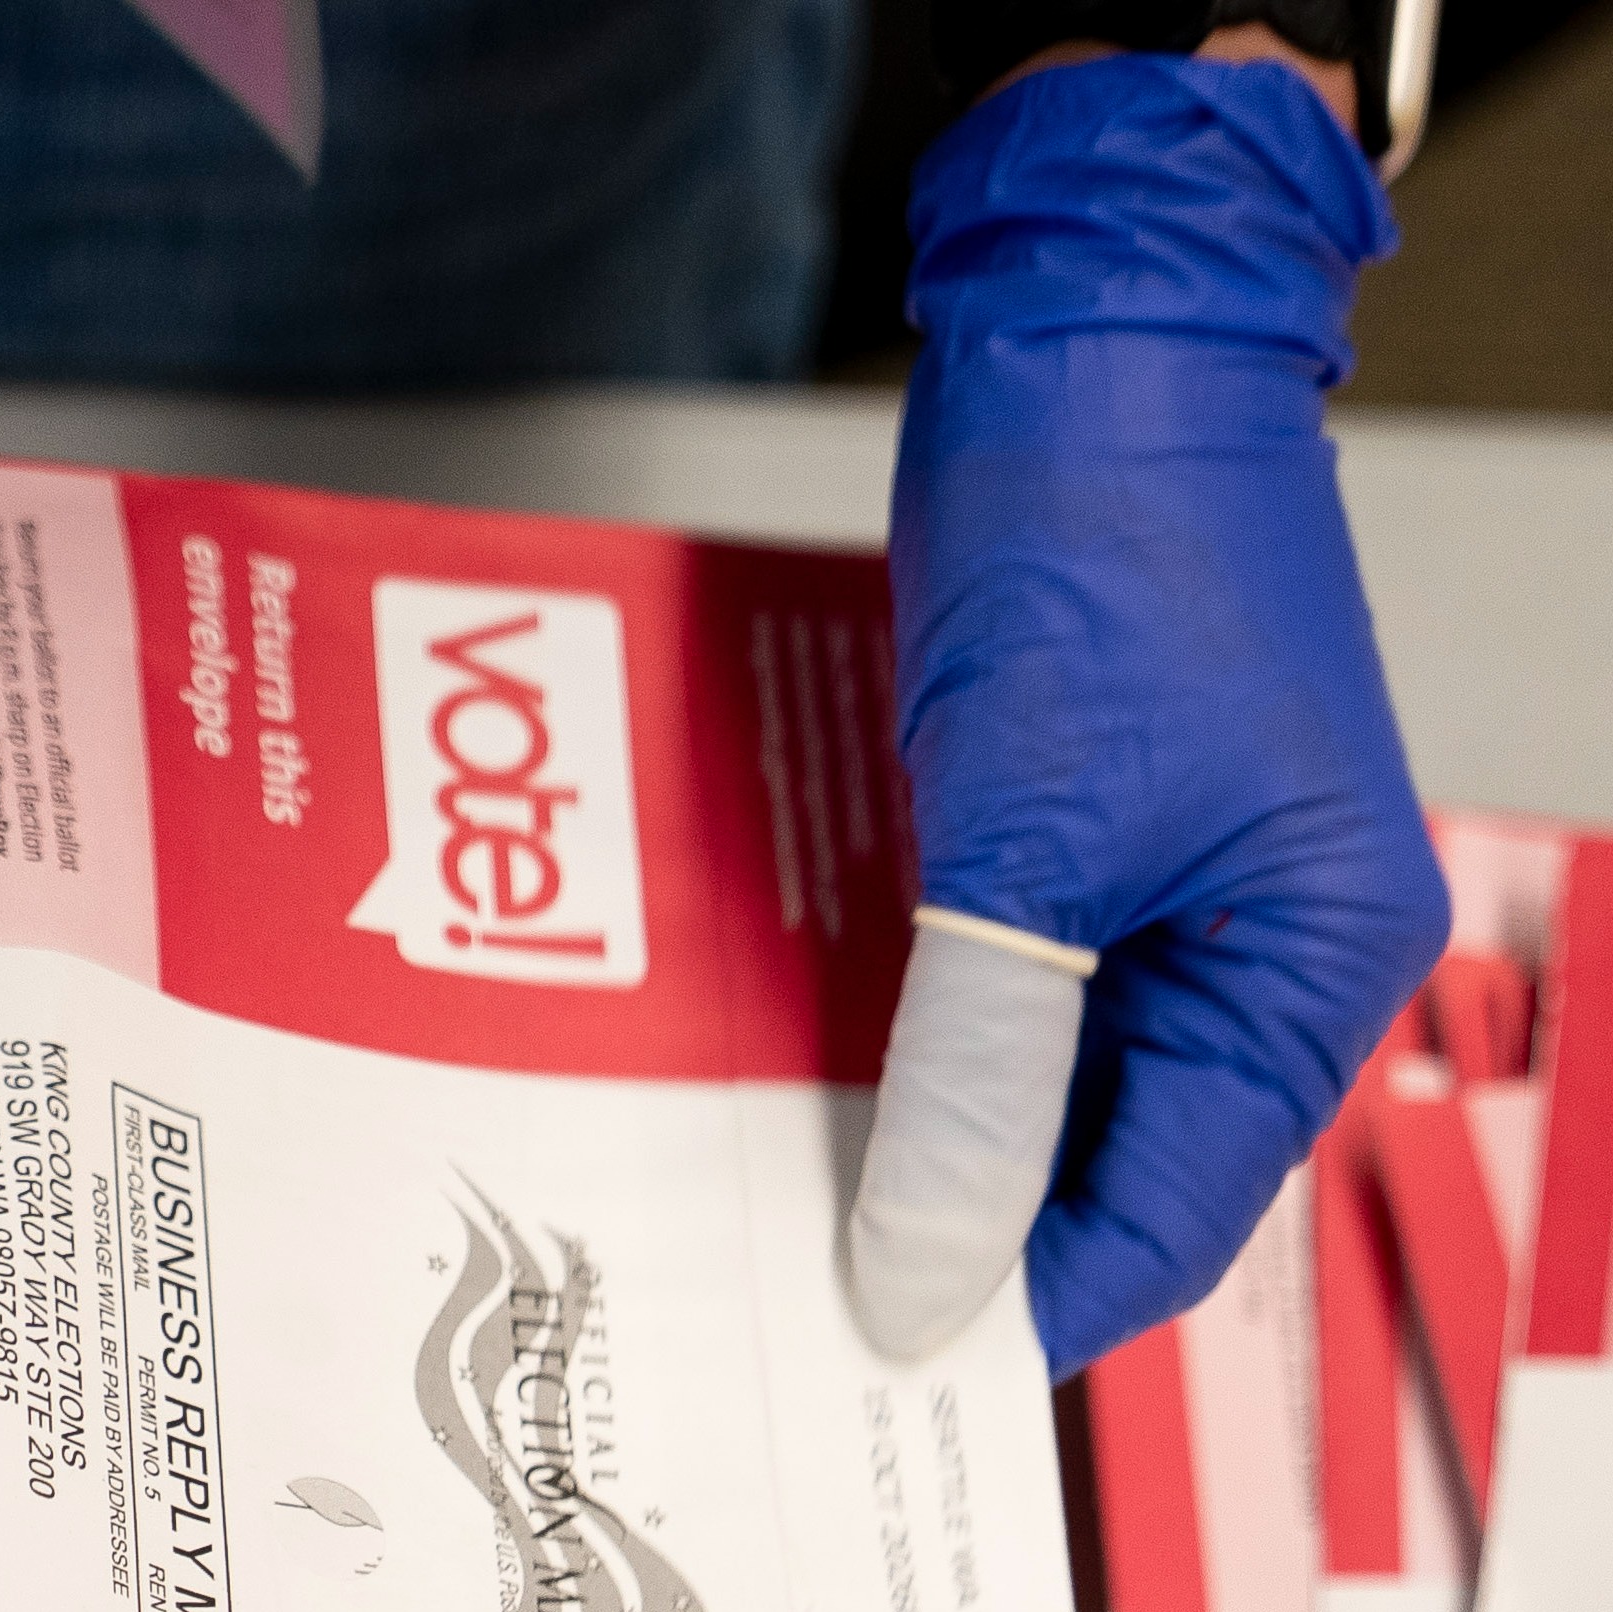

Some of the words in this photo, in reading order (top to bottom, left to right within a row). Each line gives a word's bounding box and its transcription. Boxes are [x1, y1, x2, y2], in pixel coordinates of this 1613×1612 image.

[180, 535, 237, 757] envelope
[249, 556, 298, 722] Return
[12, 750, 34, 780] on
[45, 741, 75, 812] official
[260, 731, 311, 826] this
[425, 611, 607, 958] vote!
[15, 781, 44, 863] Election
[0, 1040, 33, 1090] 919
[41, 1042, 70, 1122] KING
[6, 1099, 37, 1146] SW
[13, 1155, 45, 1272] GRADY
[48, 1128, 76, 1273] COUNTY
[126, 1105, 148, 1241] FIRST-CLASS
[92, 1173, 113, 1277] POSTAGE
[150, 1119, 202, 1384] BUSINESS
[98, 1282, 115, 1329] WILL
[132, 1243, 150, 1290] MAIL
[24, 1277, 49, 1358] WAY
[100, 1336, 117, 1368] BE
[25, 1362, 53, 1433] STE
[54, 1275, 86, 1470] ELECTIONS
[103, 1371, 121, 1423] PAID
[139, 1355, 158, 1439] PERMIT
[105, 1426, 122, 1459] BY
[508, 1289, 585, 1546] ELECTION
[28, 1436, 56, 1500] 200
[143, 1442, 161, 1477] NO.
[144, 1486, 161, 1500] 5
[165, 1395, 214, 1579] REPLY
[107, 1459, 129, 1596] ADDRESSEE
[495, 1544, 516, 1576] U.S.
